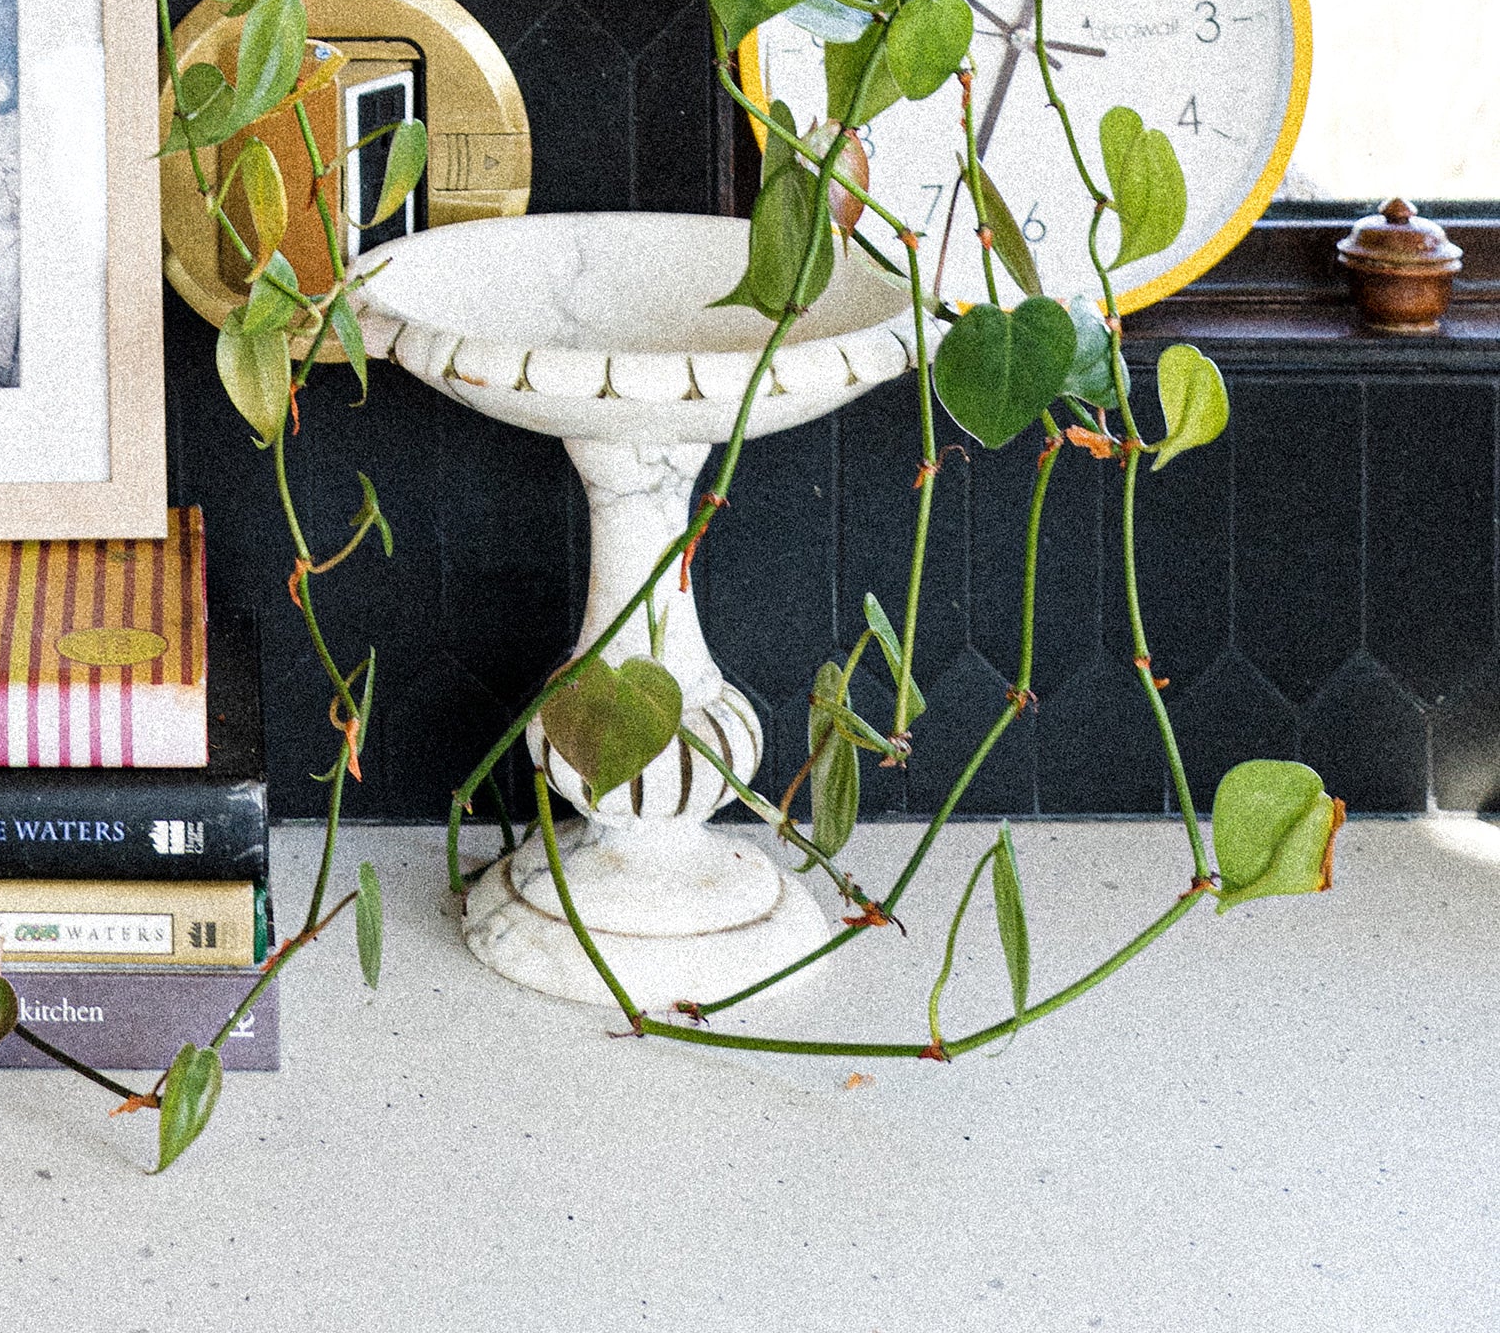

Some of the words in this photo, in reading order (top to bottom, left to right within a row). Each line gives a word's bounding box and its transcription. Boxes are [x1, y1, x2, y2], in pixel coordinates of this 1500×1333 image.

[1195, 1, 1222, 44] 3
[1177, 94, 1203, 135] 4
[920, 183, 944, 225] 7
[1022, 201, 1048, 244] 6
[14, 820, 125, 843] WATERS
[66, 926, 166, 942] WATERS
[20, 996, 104, 1023] kitchen
